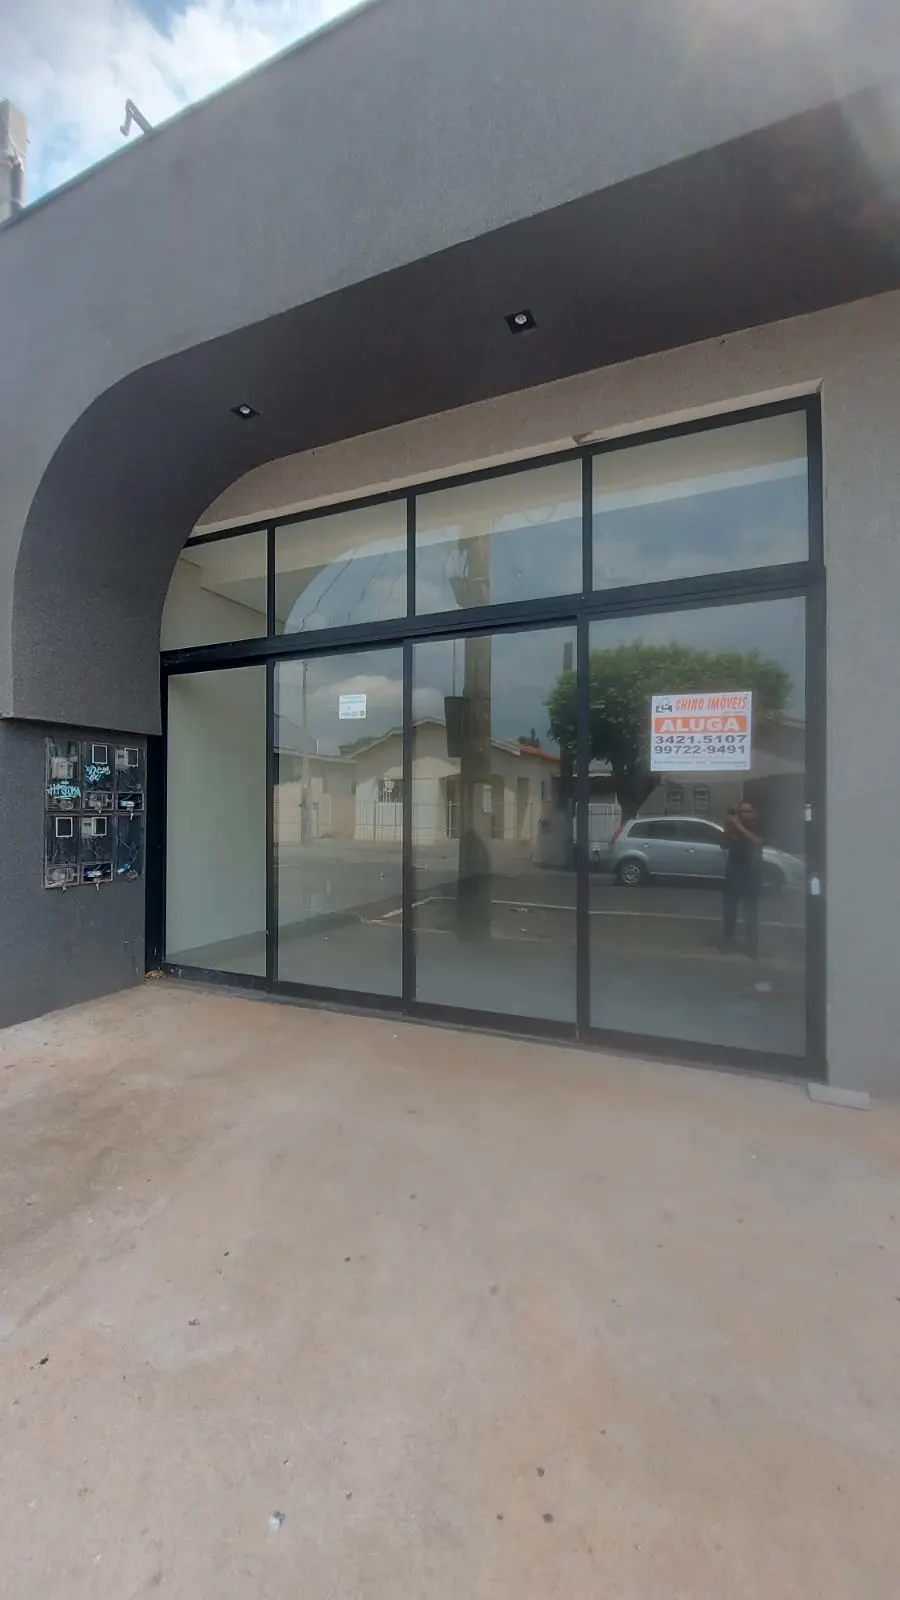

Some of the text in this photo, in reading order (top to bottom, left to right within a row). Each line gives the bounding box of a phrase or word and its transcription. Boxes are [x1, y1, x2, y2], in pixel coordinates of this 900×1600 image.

[676, 698, 704, 711] CHINO
[660, 718, 740, 732] ALUGA
[655, 735, 747, 744] 3421.5107
[654, 745, 745, 754] 99722-9491
